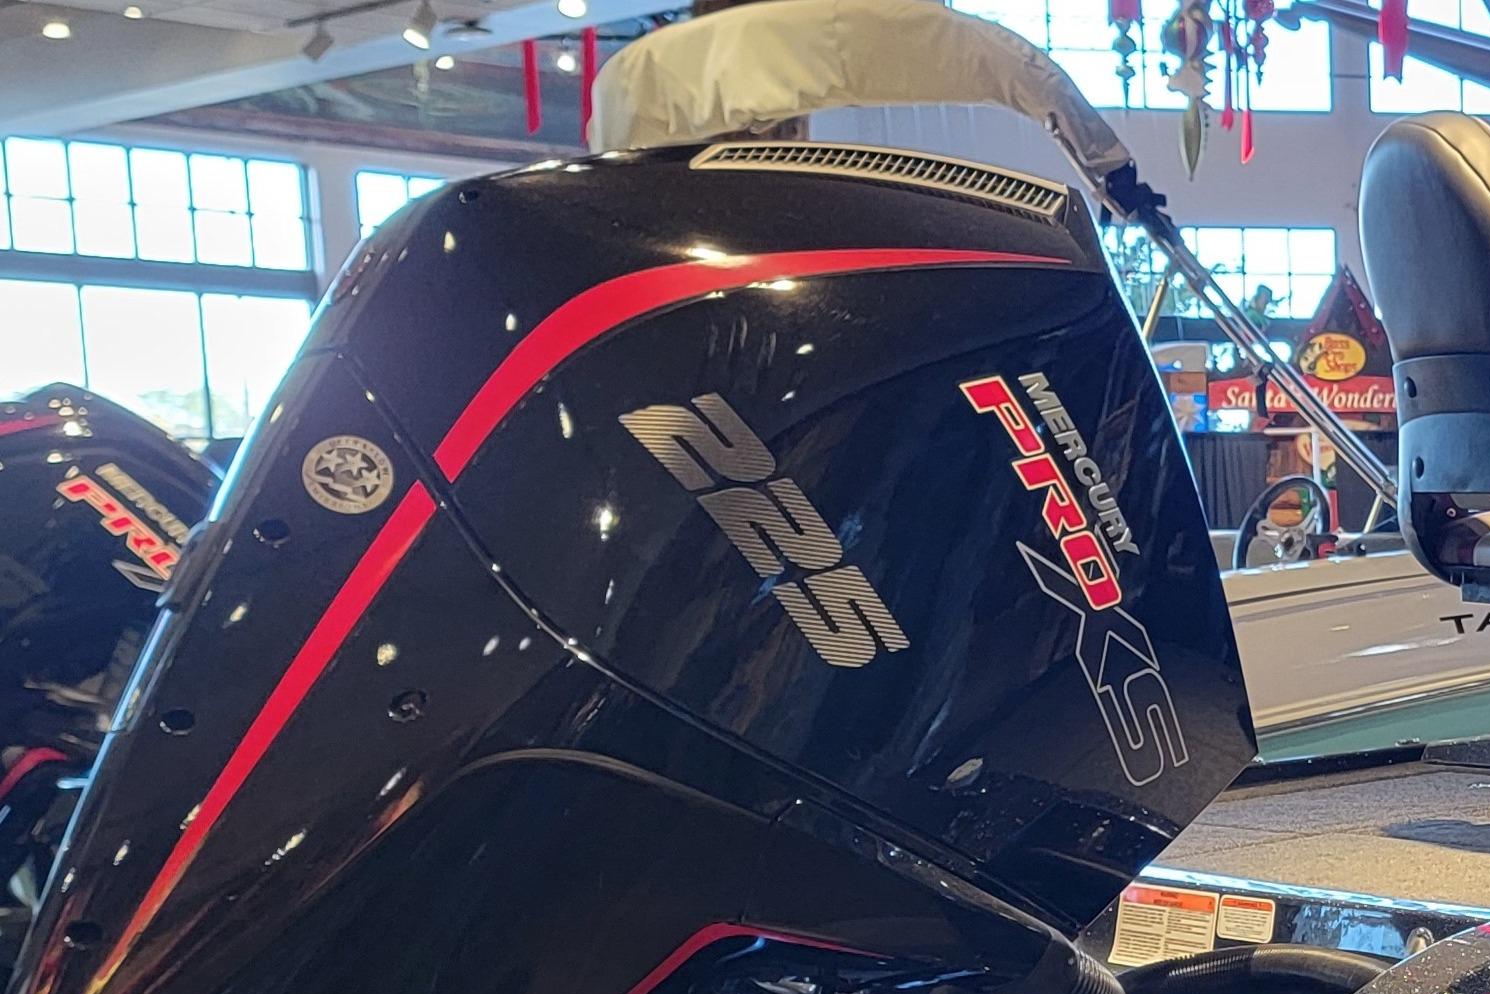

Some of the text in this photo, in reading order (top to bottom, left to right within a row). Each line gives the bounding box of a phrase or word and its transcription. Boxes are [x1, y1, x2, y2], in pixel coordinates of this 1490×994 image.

[1325, 337, 1350, 350] Bass
[618, 392, 910, 667] 225
[958, 375, 1122, 611] PRO
[1017, 372, 1140, 556] MERCURY
[1016, 520, 1189, 786] XS
